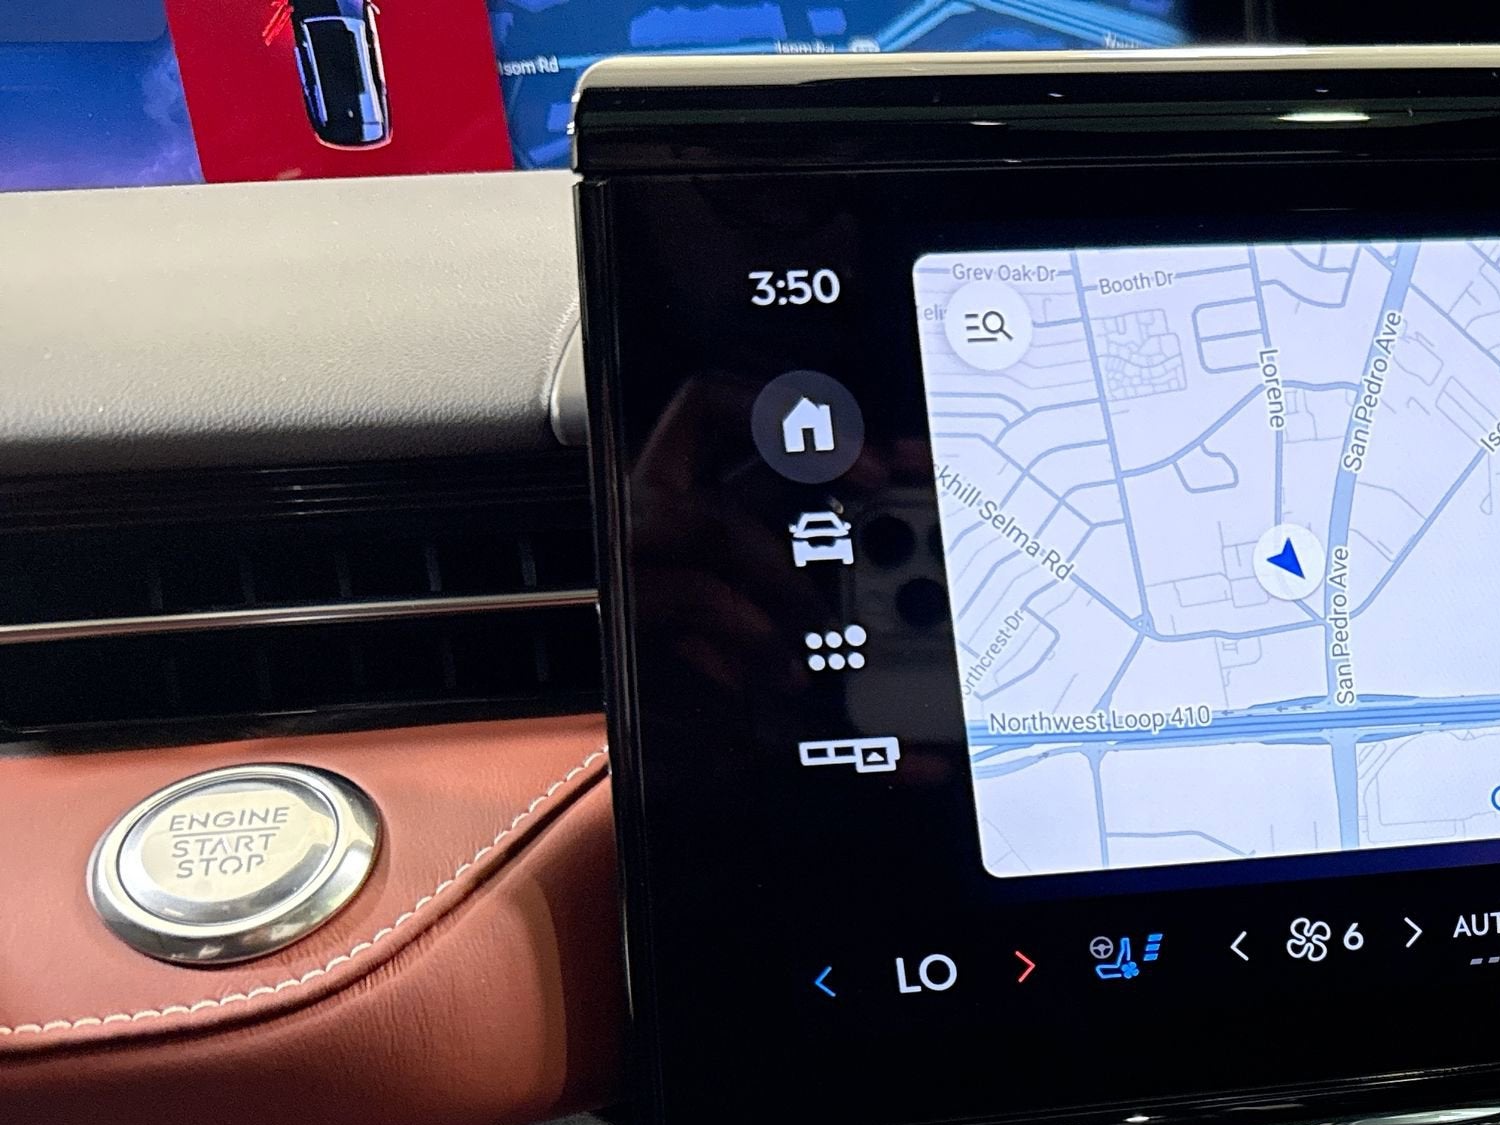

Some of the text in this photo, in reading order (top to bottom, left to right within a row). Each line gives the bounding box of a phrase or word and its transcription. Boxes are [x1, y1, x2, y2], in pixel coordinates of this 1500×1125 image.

[748, 268, 841, 306] 3:50
[997, 264, 1032, 281] Oak
[1037, 266, 1057, 282] Dr
[1099, 270, 1174, 295] Booth Dr
[1259, 348, 1285, 429] Lorene
[1343, 311, 1402, 472] San Pedro Ave
[978, 499, 1043, 555] Selma
[1041, 549, 1074, 581] Rd
[1011, 609, 1025, 631] Dr
[1329, 548, 1355, 704] San Pedro Ave
[989, 705, 1210, 732] Northwest Loop 410
[169, 807, 290, 832] ENGINE
[171, 833, 277, 859] START
[176, 854, 265, 879] STOP
[1342, 922, 1365, 951] 6
[895, 953, 957, 994] LO
